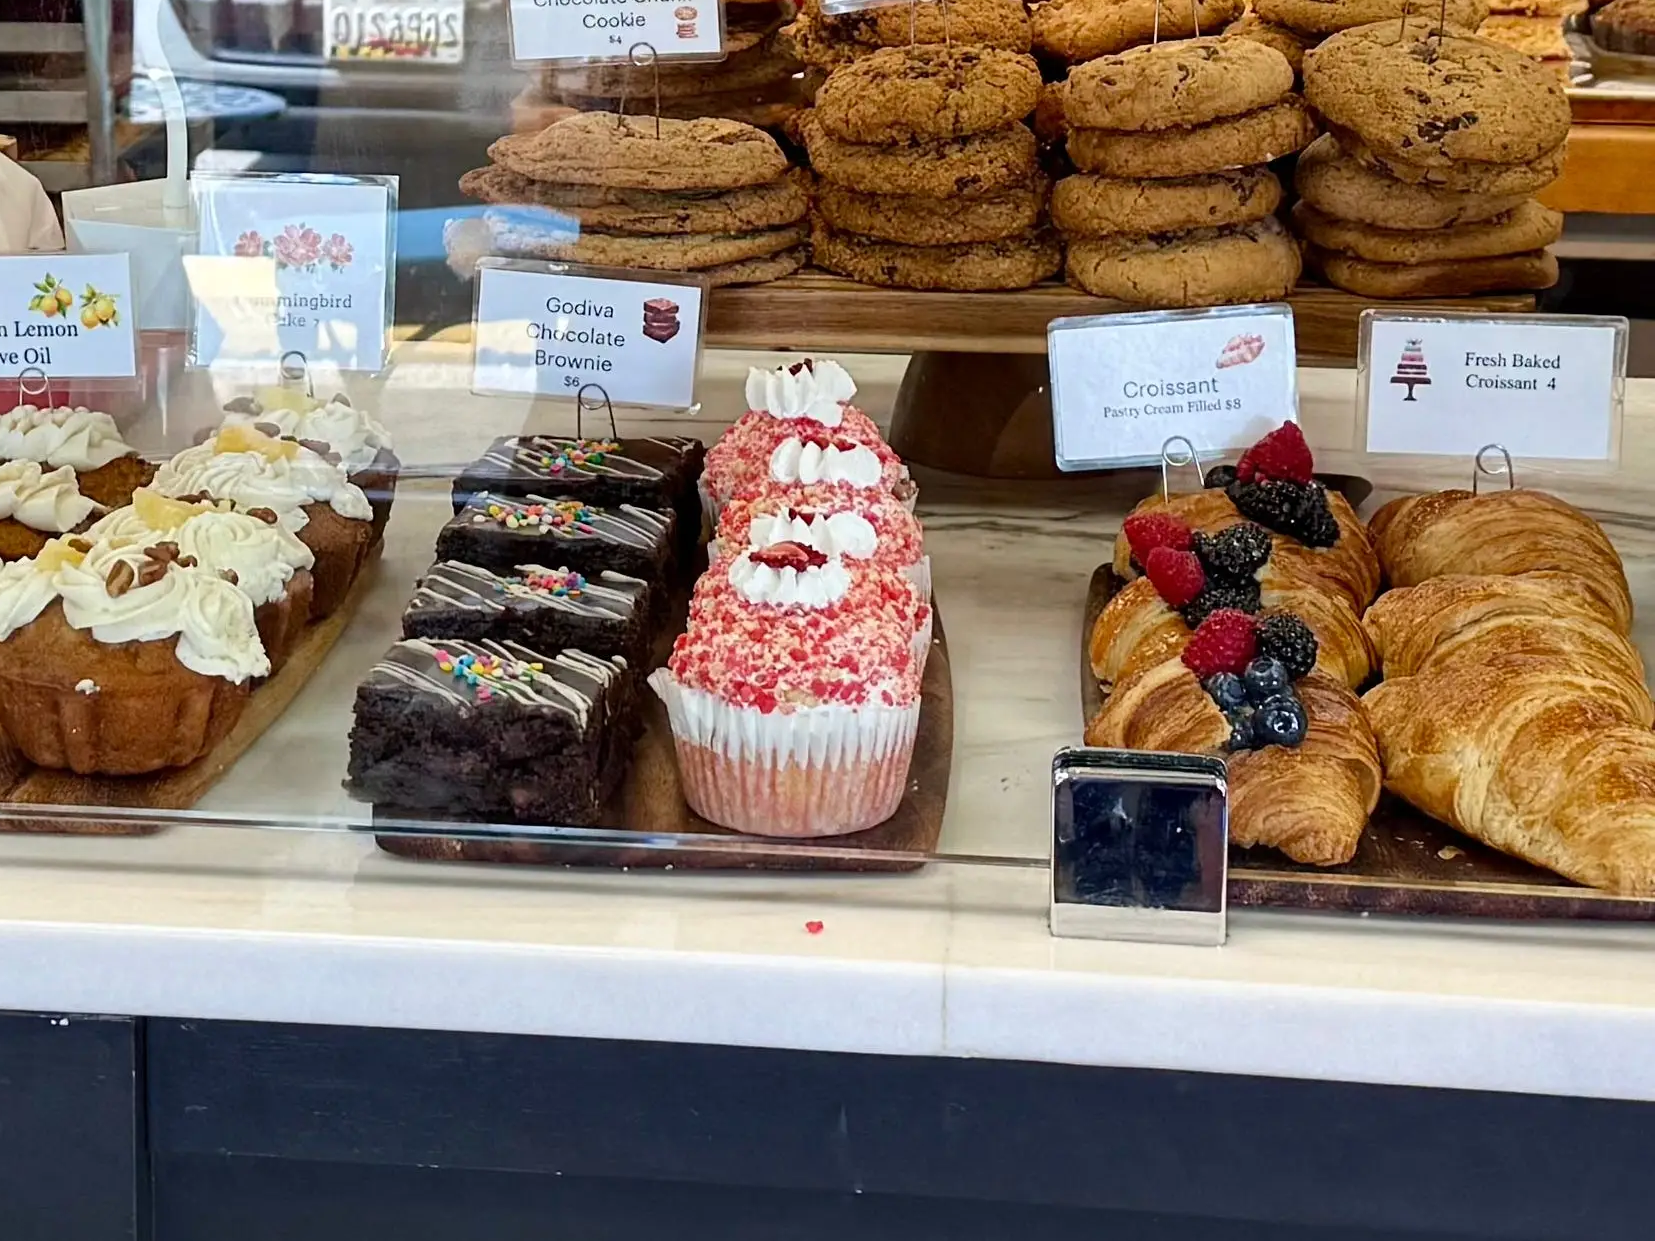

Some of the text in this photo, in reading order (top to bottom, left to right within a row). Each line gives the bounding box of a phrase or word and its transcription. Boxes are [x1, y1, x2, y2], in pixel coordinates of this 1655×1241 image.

[583, 12, 646, 29] Cookie
[546, 296, 614, 318] Godiva
[14, 321, 79, 338] Lemon
[526, 322, 625, 347] Chocolate
[24, 346, 52, 365] Oil
[535, 349, 613, 372] Brownie
[1465, 352, 1561, 369] Fresh Baked
[564, 375, 580, 388] $6
[1123, 376, 1219, 399] Croissant
[1466, 374, 1556, 390] Croissant 4
[1103, 398, 1242, 419] Pastry Cream Filled $8
